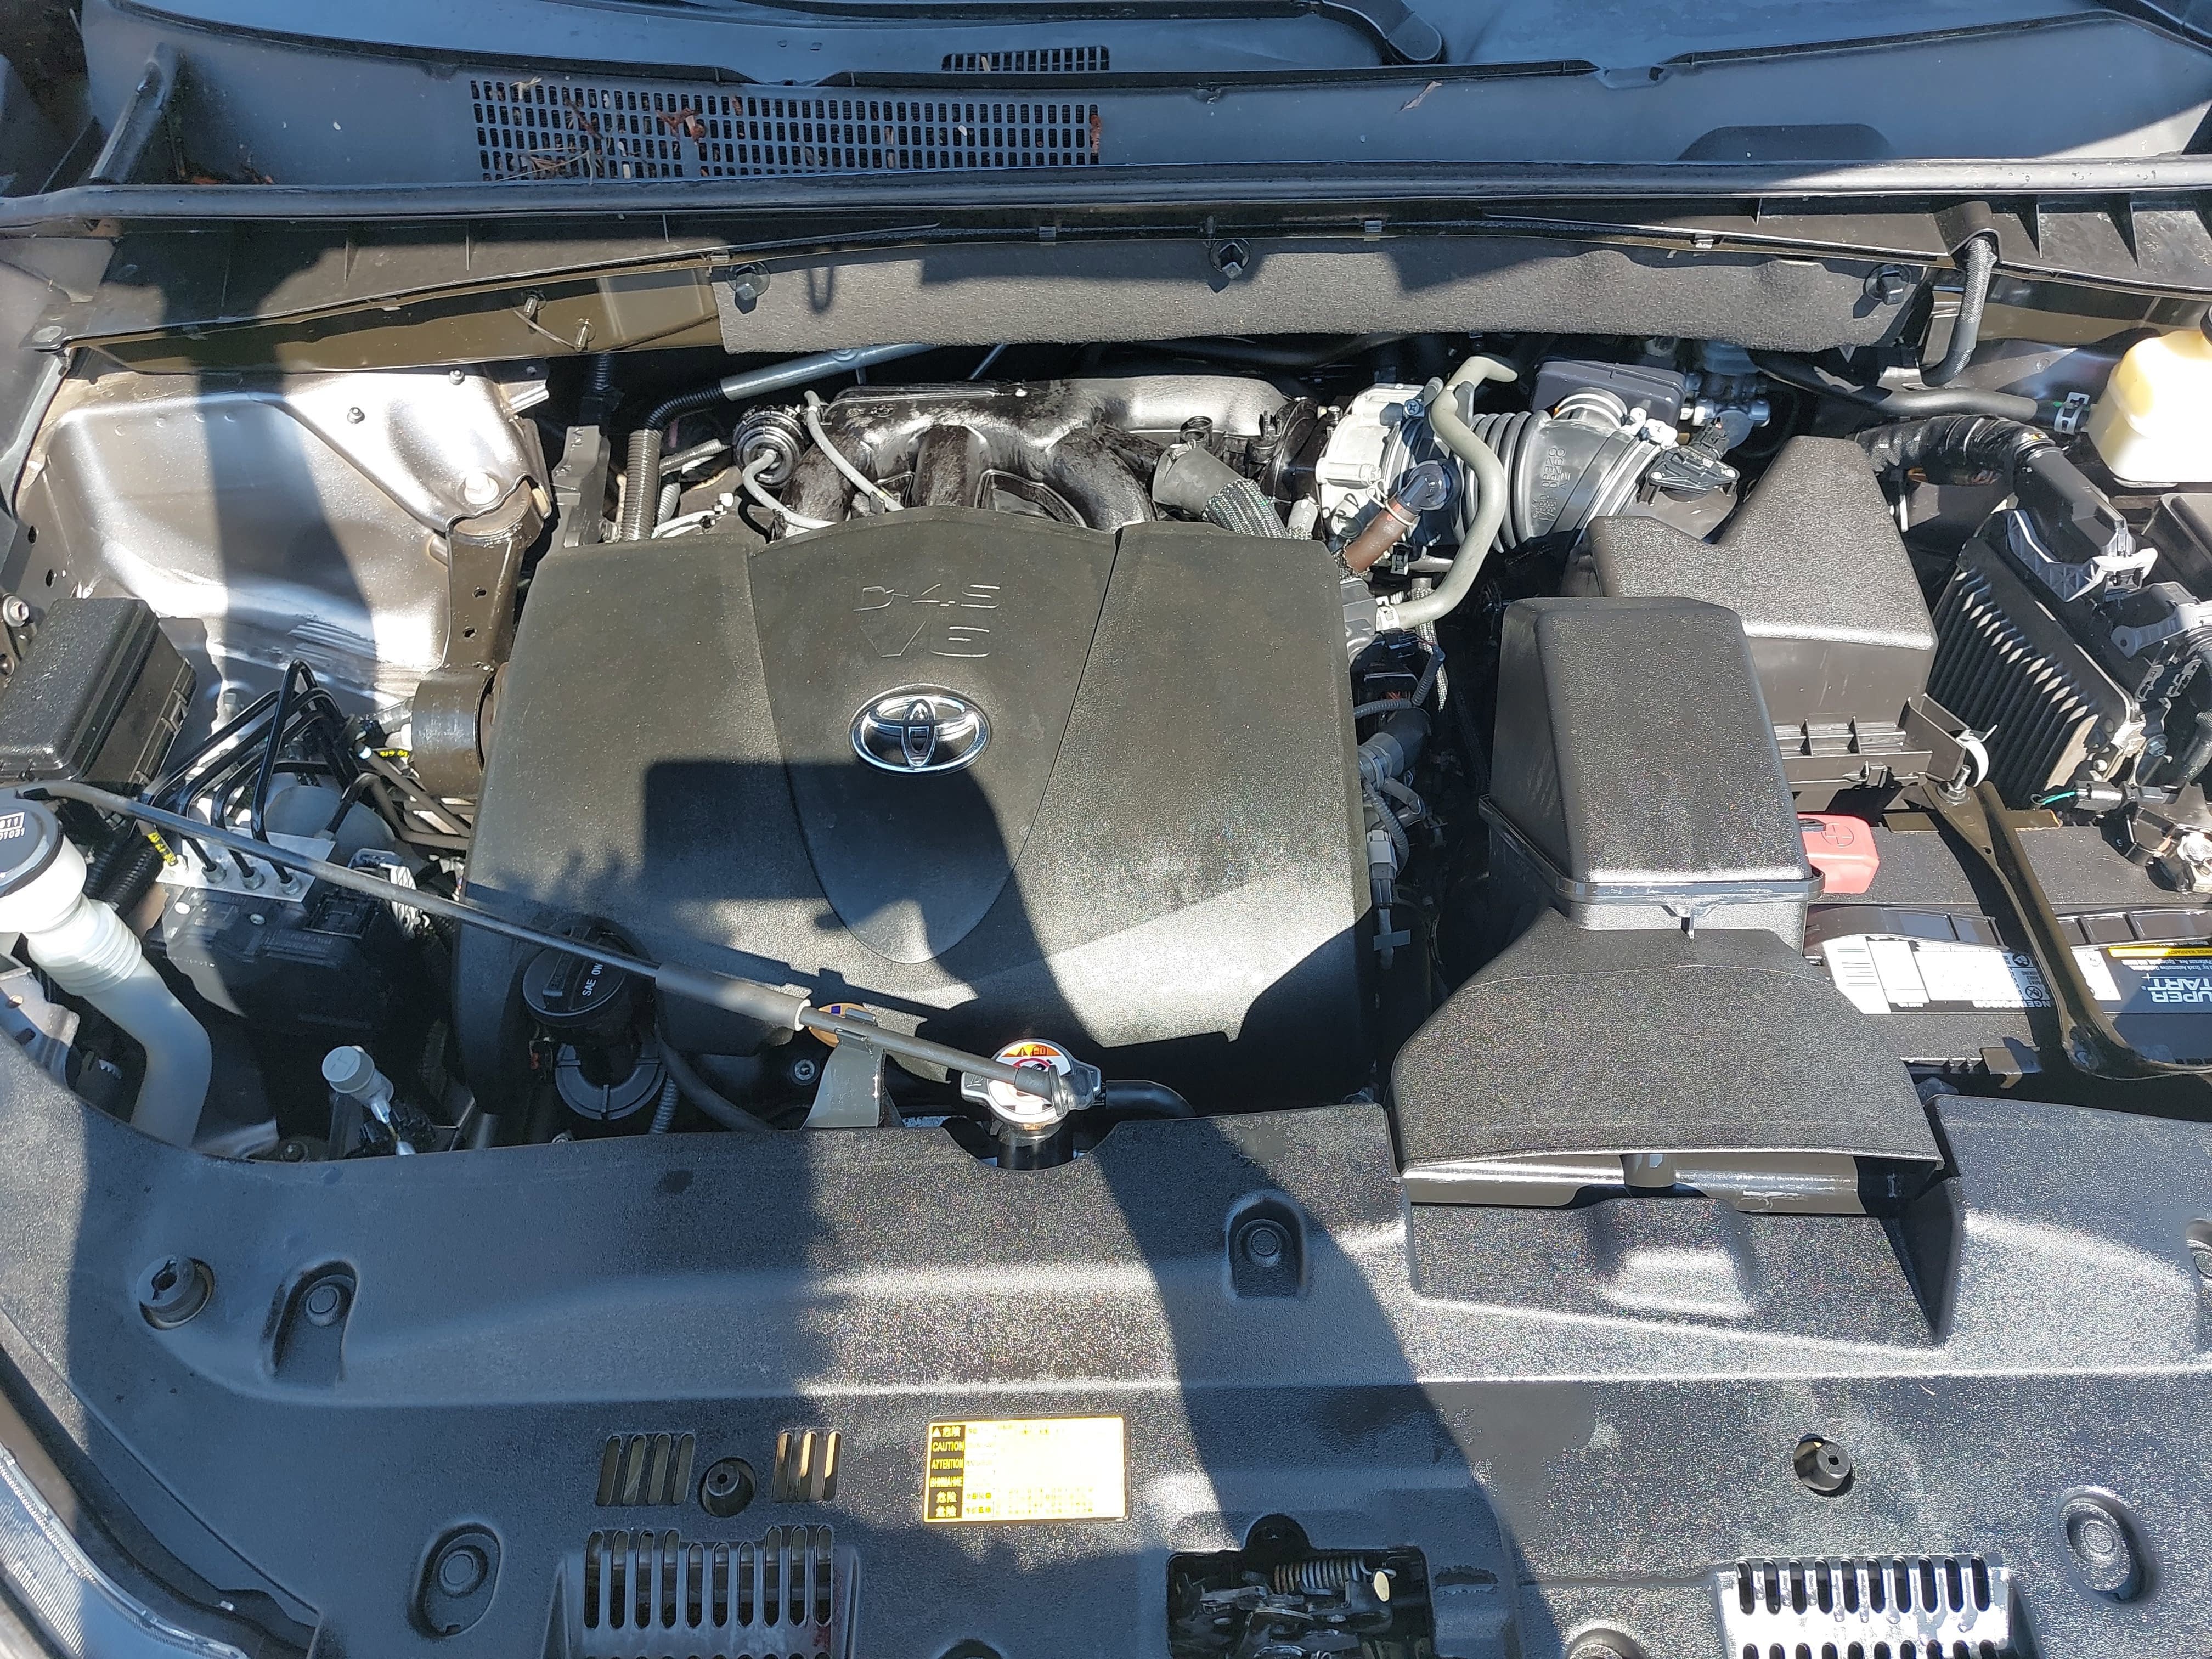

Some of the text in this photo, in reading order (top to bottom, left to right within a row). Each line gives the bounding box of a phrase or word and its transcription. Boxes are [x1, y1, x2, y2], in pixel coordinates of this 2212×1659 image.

[860, 620, 990, 658] V6
[582, 979, 597, 996] SAE
[2147, 978, 2212, 991] TART
[2151, 991, 2212, 1003] UPER
[932, 1441, 964, 1452] CAUTION
[931, 1458, 964, 1470] ATTENTION
[930, 1476, 963, 1488] ВНИМАНИЕ
